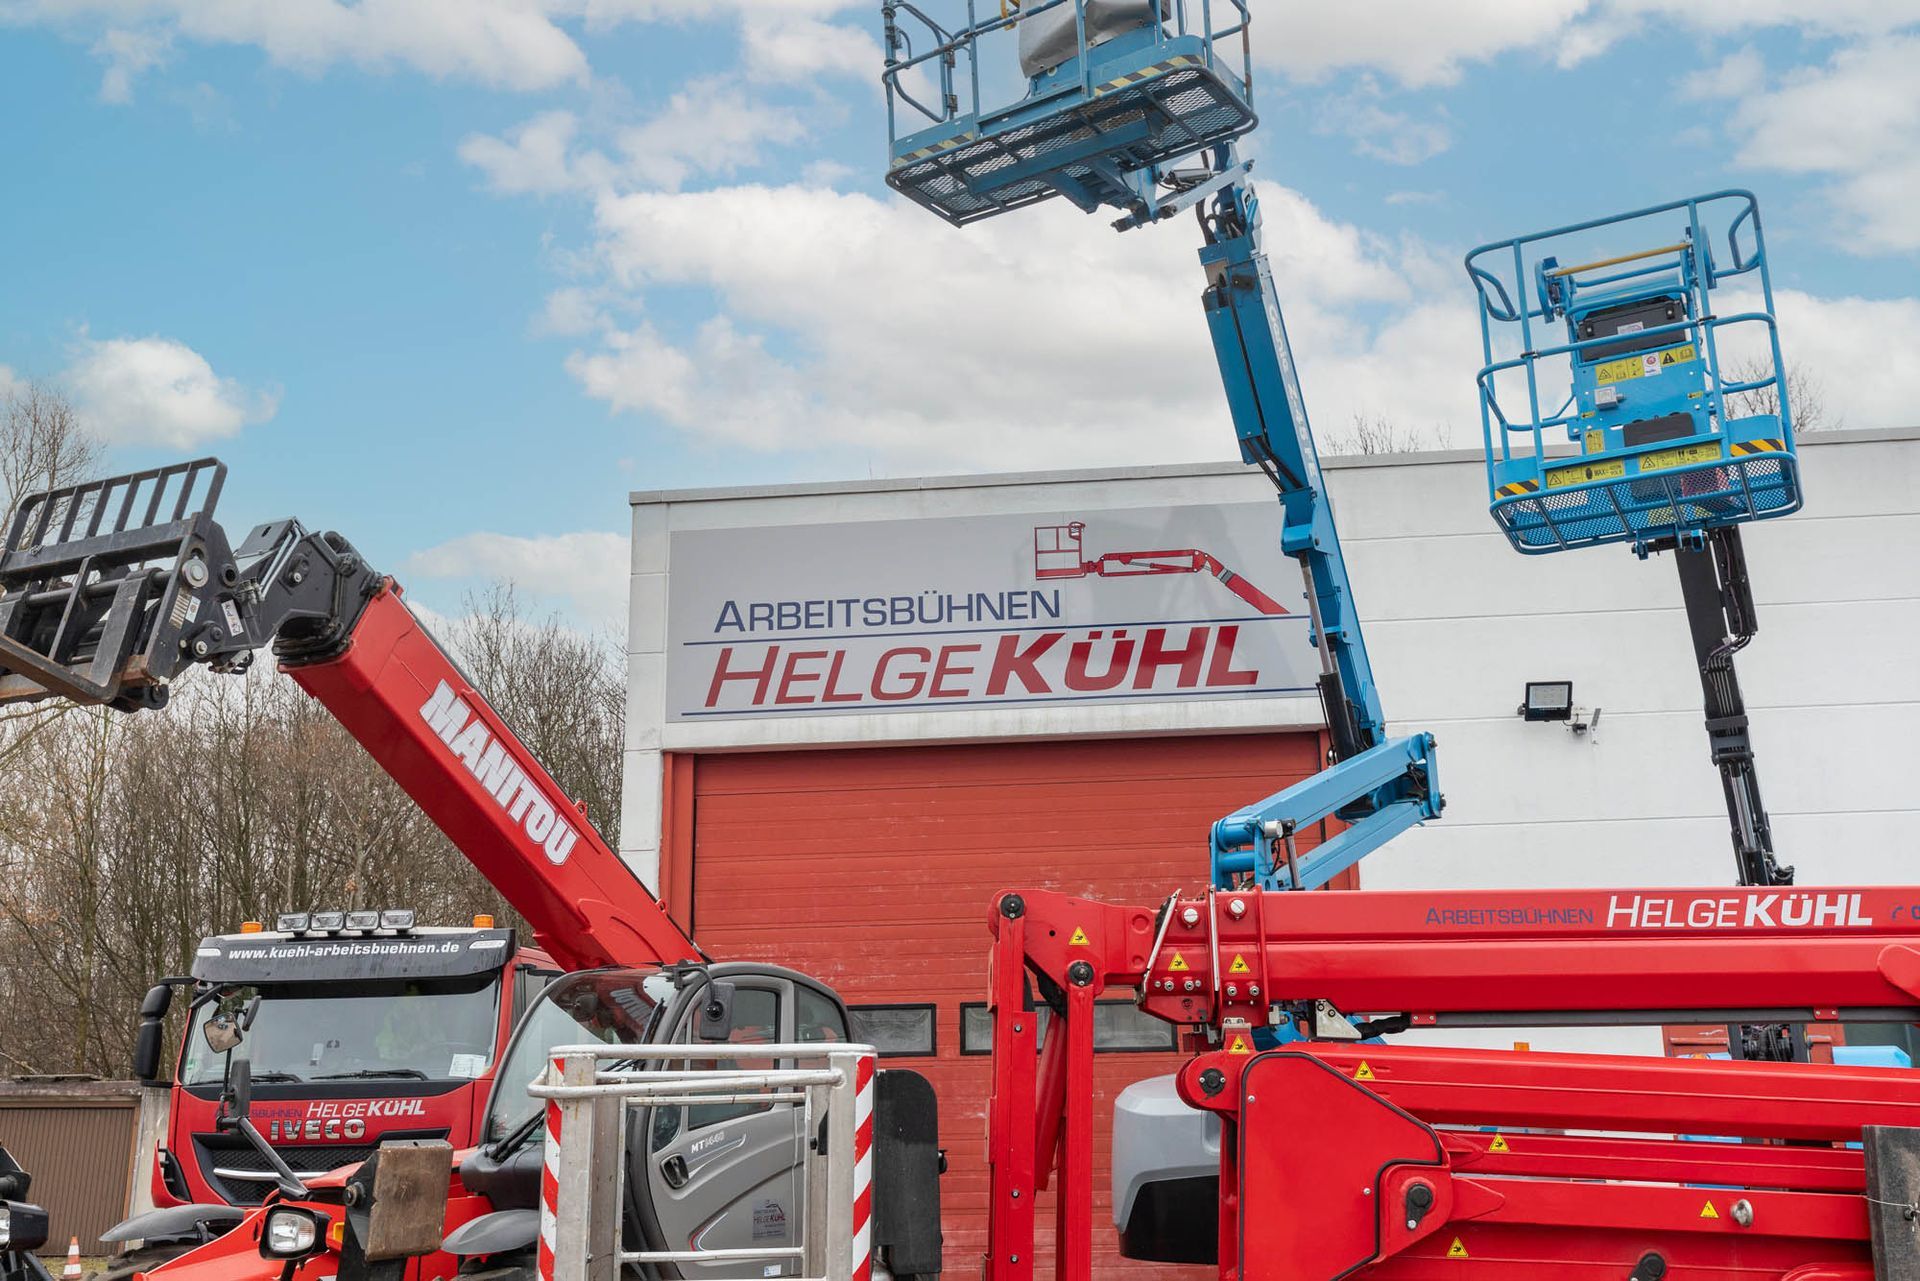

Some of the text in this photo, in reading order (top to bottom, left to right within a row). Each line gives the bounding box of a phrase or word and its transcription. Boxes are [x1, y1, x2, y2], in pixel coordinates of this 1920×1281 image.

[713, 589, 1061, 633] ARBEITSBÜHNEN
[419, 678, 580, 866] MANITOU
[1425, 906, 1594, 925] ARBEITSBÜHNEN
[228, 941, 460, 960] www.kuehl-arbeitsbuehnen.de
[270, 1118, 366, 1141] IVECO
